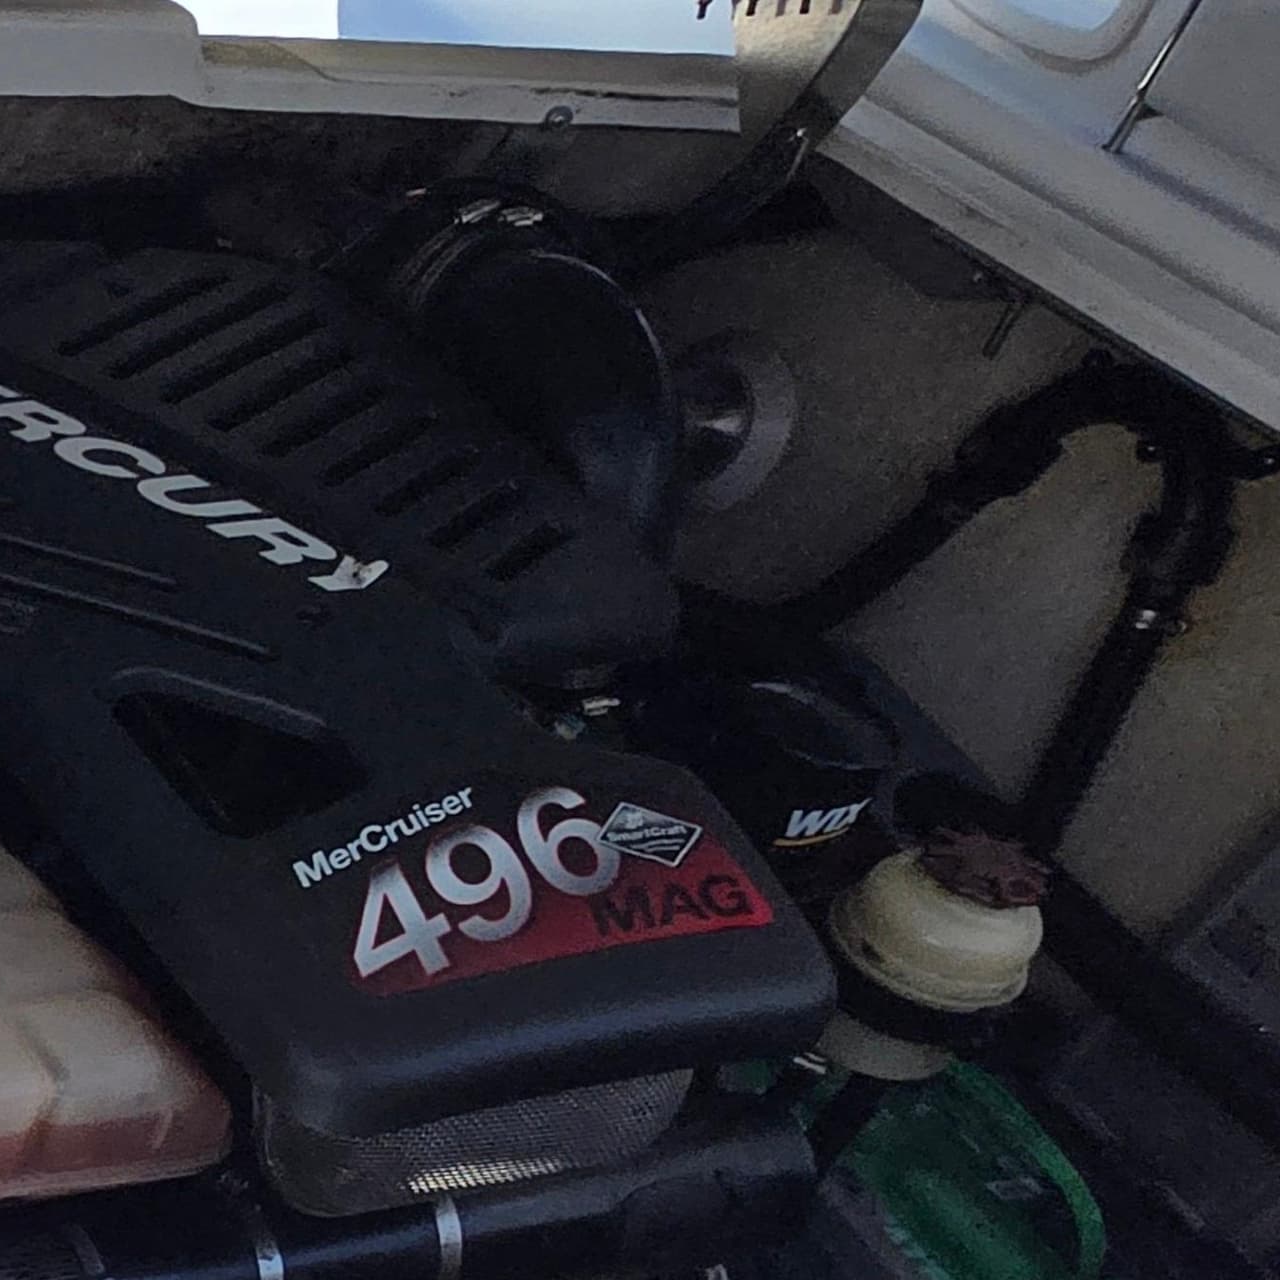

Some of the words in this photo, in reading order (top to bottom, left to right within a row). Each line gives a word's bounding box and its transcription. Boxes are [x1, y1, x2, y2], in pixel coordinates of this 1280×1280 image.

[292, 786, 473, 888] MerCruiser
[606, 825, 687, 843] SmartCraft
[353, 786, 620, 978] 496
[590, 874, 753, 937] MAG
